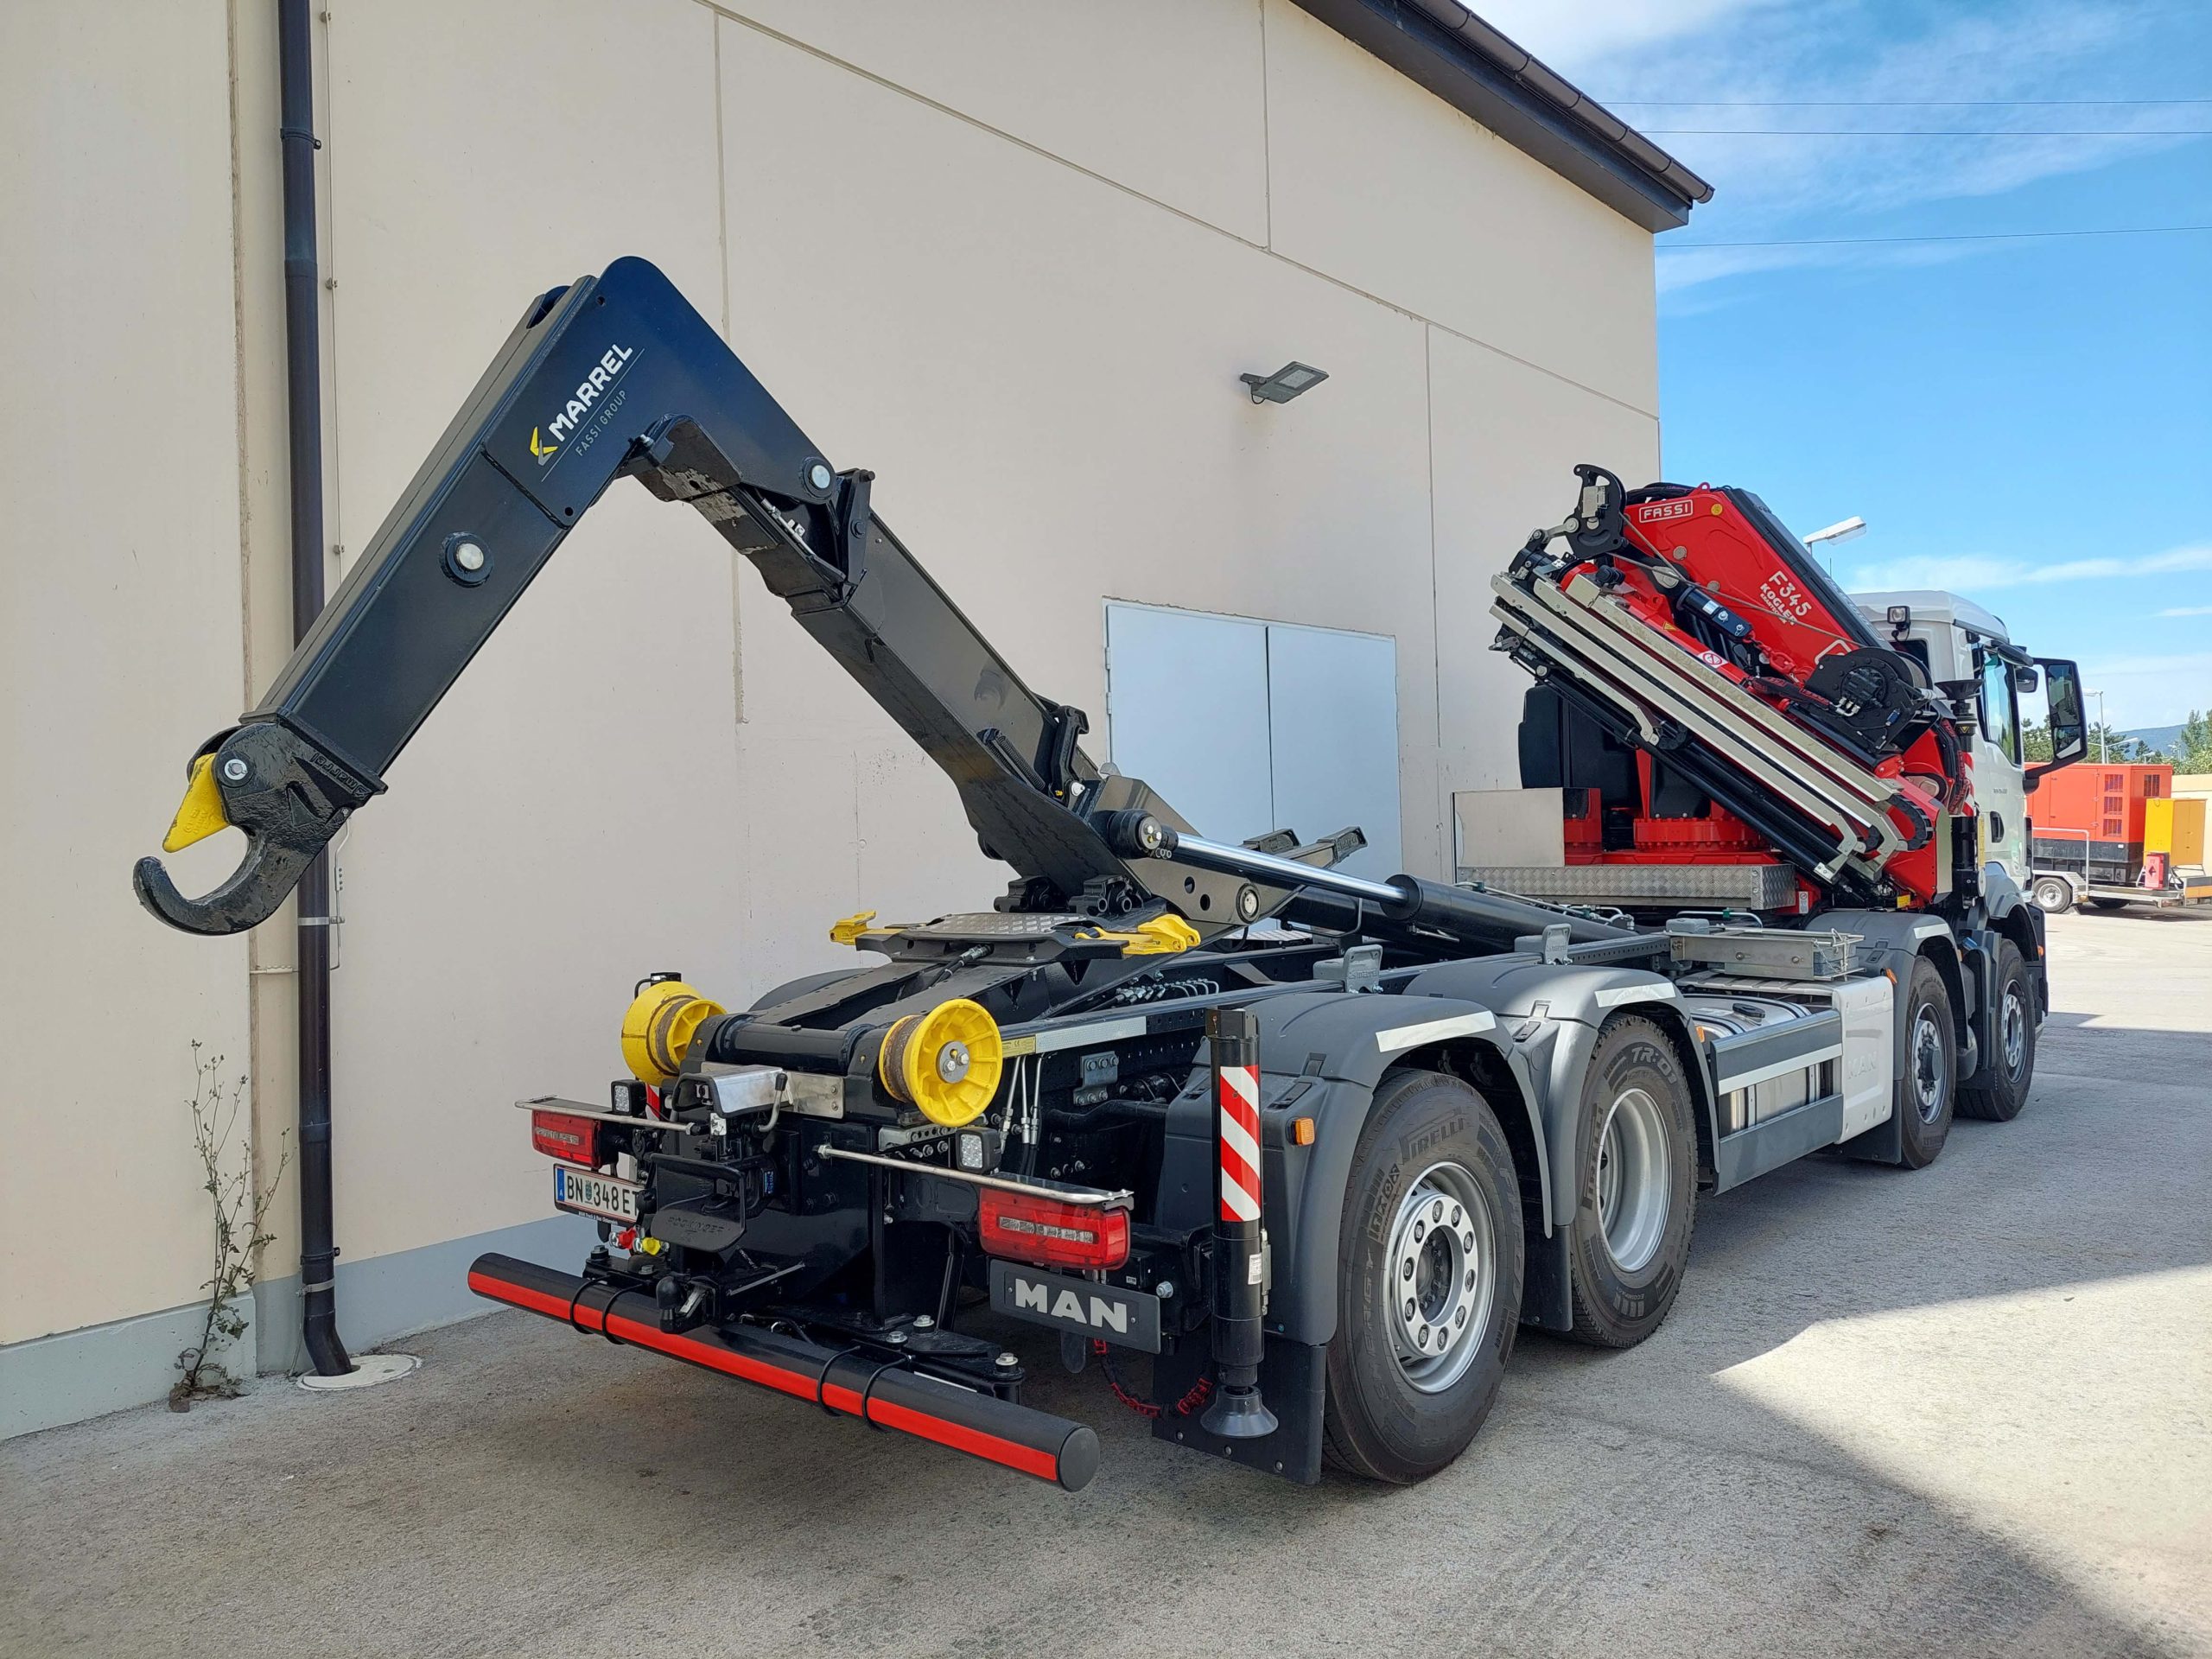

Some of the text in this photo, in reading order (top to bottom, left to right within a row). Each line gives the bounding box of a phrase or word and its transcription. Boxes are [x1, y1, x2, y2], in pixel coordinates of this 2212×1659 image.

[548, 344, 633, 442] MARREL
[575, 390, 627, 457] FASSI GROUP
[1643, 503, 1688, 519] FASSI
[1768, 570, 1813, 616] F345
[567, 1175, 583, 1203] BN
[593, 1182, 620, 1211] 348
[1015, 1278, 1127, 1334] MAN
